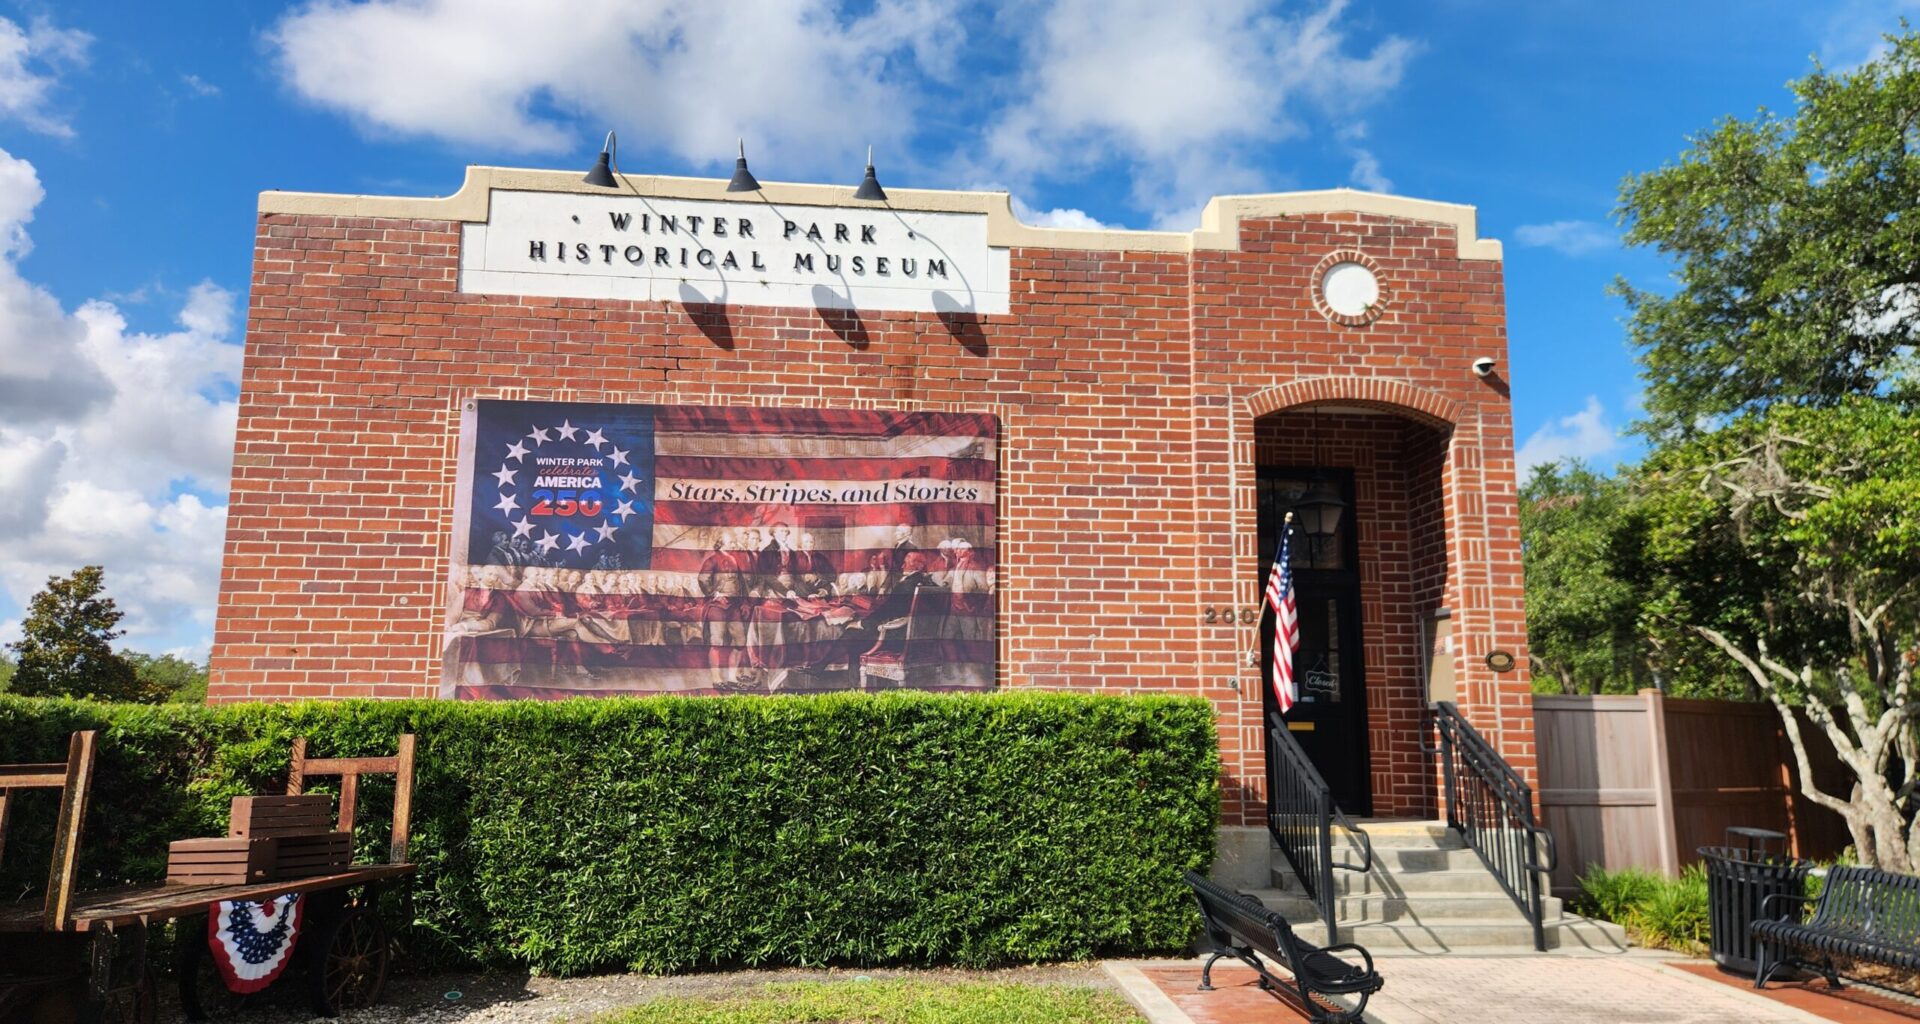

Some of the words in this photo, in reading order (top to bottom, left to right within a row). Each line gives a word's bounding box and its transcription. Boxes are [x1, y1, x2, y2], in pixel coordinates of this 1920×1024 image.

[608, 211, 753, 237] WINTER
[783, 220, 875, 243] PARK
[528, 240, 764, 269] HISTORICAL
[793, 253, 947, 277] MUSEUM
[536, 457, 575, 466] WINTER
[577, 458, 604, 467] PARK
[540, 465, 599, 476] celebrates
[533, 475, 602, 489] AMERICA
[668, 481, 740, 503] Stars,
[744, 482, 838, 506] Stripes,
[841, 482, 889, 503] and
[893, 480, 979, 502] Stories
[530, 489, 603, 517] 250
[1205, 606, 1255, 625] 200
[1308, 674, 1337, 688] Closed
